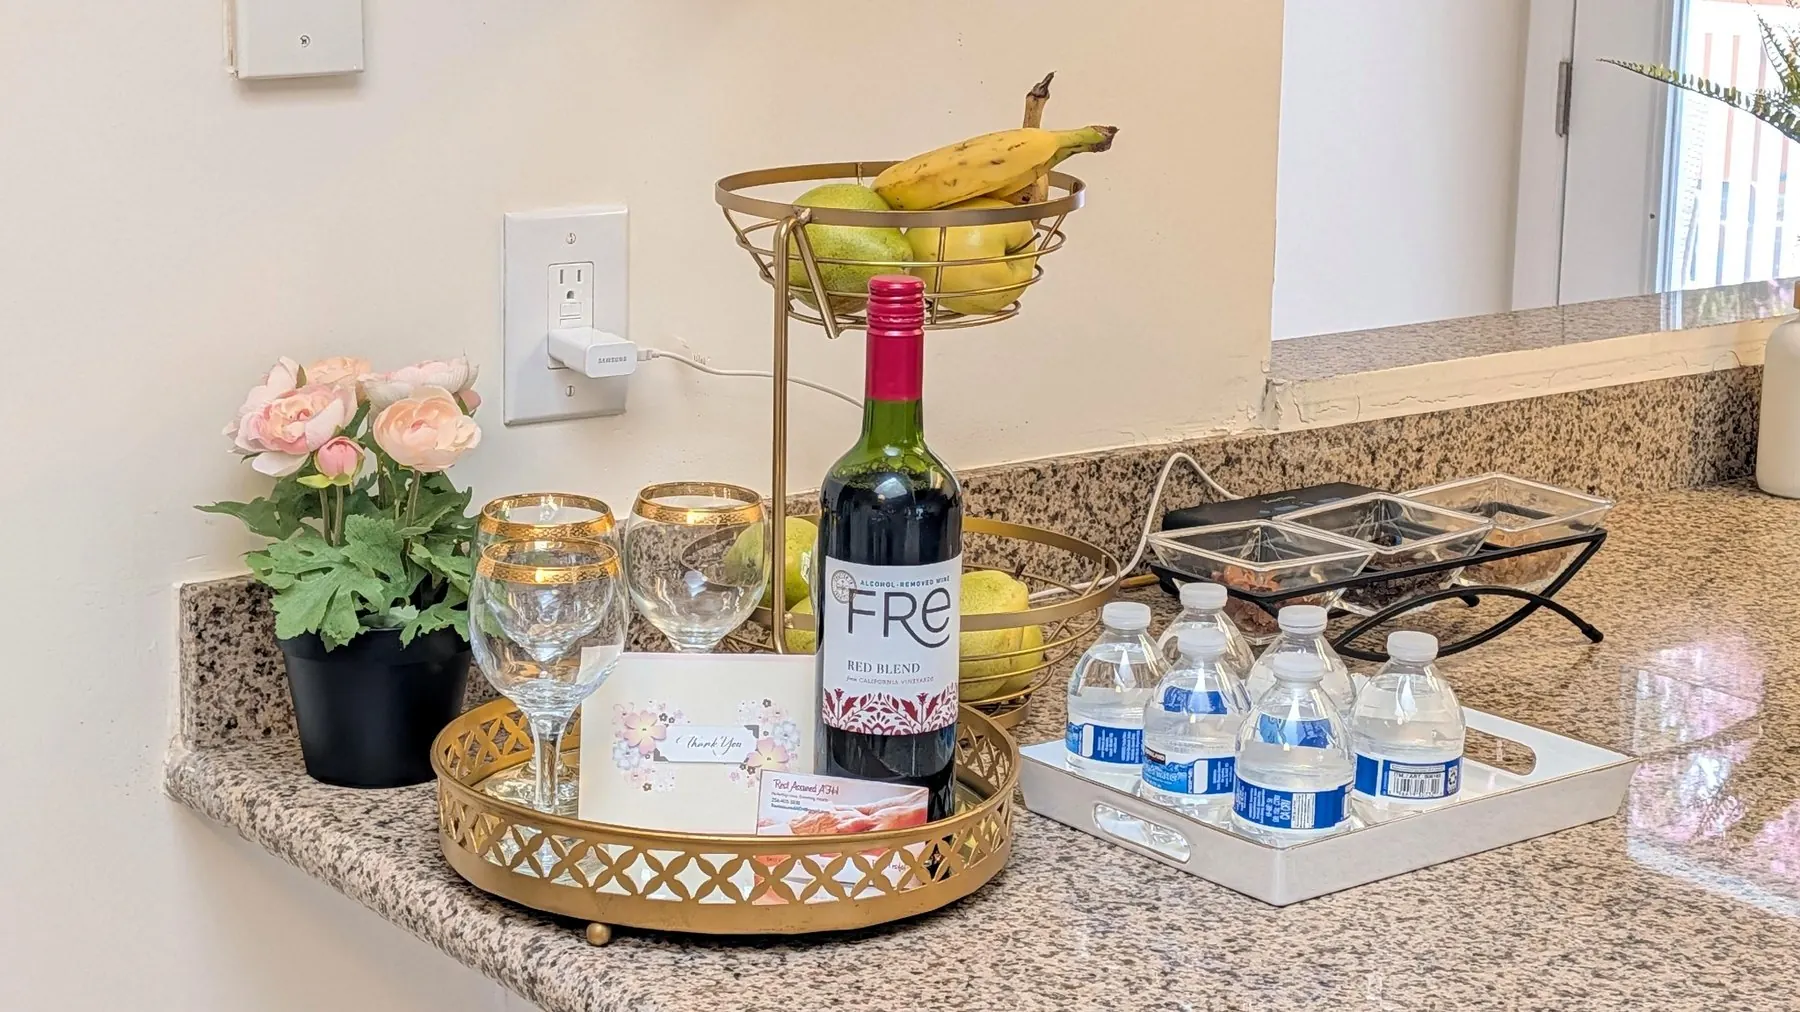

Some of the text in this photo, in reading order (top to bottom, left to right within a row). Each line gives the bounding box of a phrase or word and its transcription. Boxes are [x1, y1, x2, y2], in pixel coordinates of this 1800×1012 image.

[860, 575, 950, 588] ALCOHOL-REMOVED WINE
[847, 659, 921, 674] RED BLEND
[859, 677, 899, 685] CALIFORNIA
[901, 676, 935, 685] VINEYARDS
[675, 735, 742, 756] Thank You
[773, 778, 789, 790] Rest
